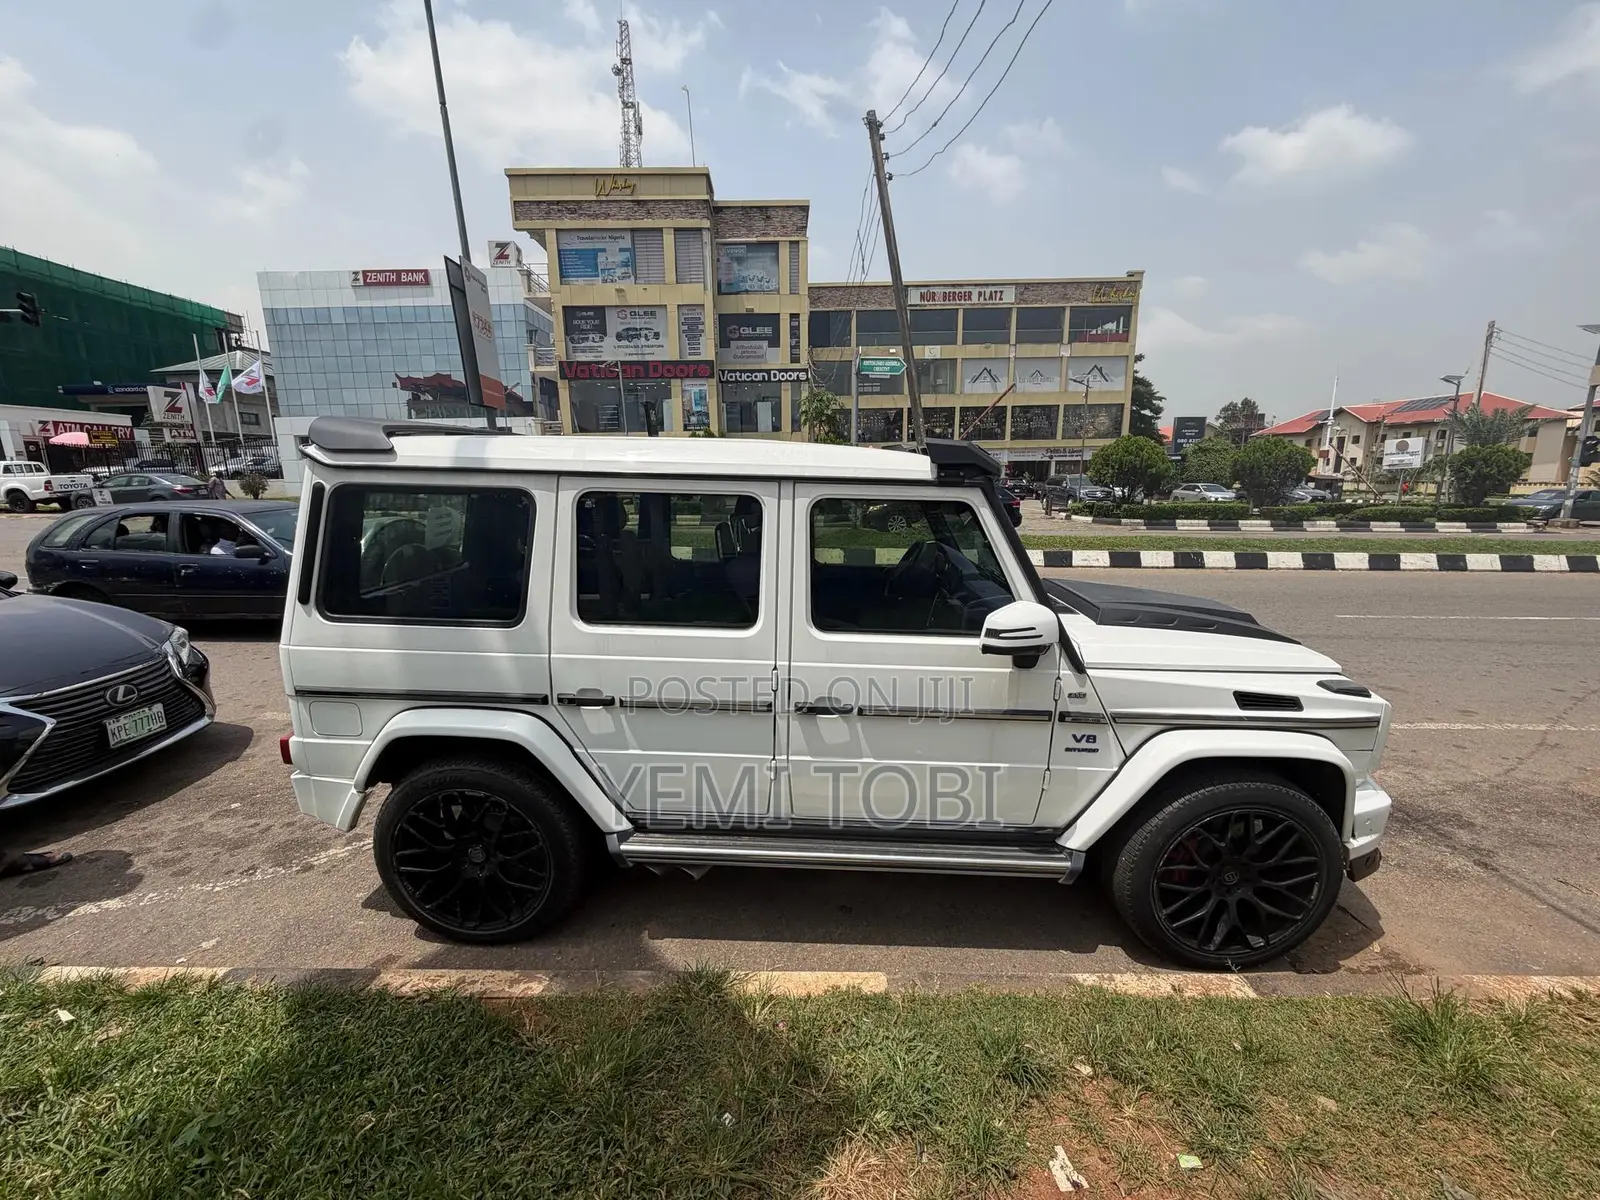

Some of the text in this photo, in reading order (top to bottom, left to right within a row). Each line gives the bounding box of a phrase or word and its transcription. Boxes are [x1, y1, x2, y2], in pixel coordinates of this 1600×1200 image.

[366, 271, 426, 283] ZENITH BANK
[977, 290, 1004, 302] PLATZ
[740, 326, 773, 334] GLEE
[562, 361, 712, 378] Vatican Doors
[718, 370, 807, 382] Vatican Doors
[162, 412, 185, 421] ZENITH
[57, 422, 80, 434] ATM
[171, 429, 195, 438] ATM
[58, 482, 89, 490] TOYOTA
[110, 722, 130, 742] KPE
[1072, 733, 1097, 744] V8
